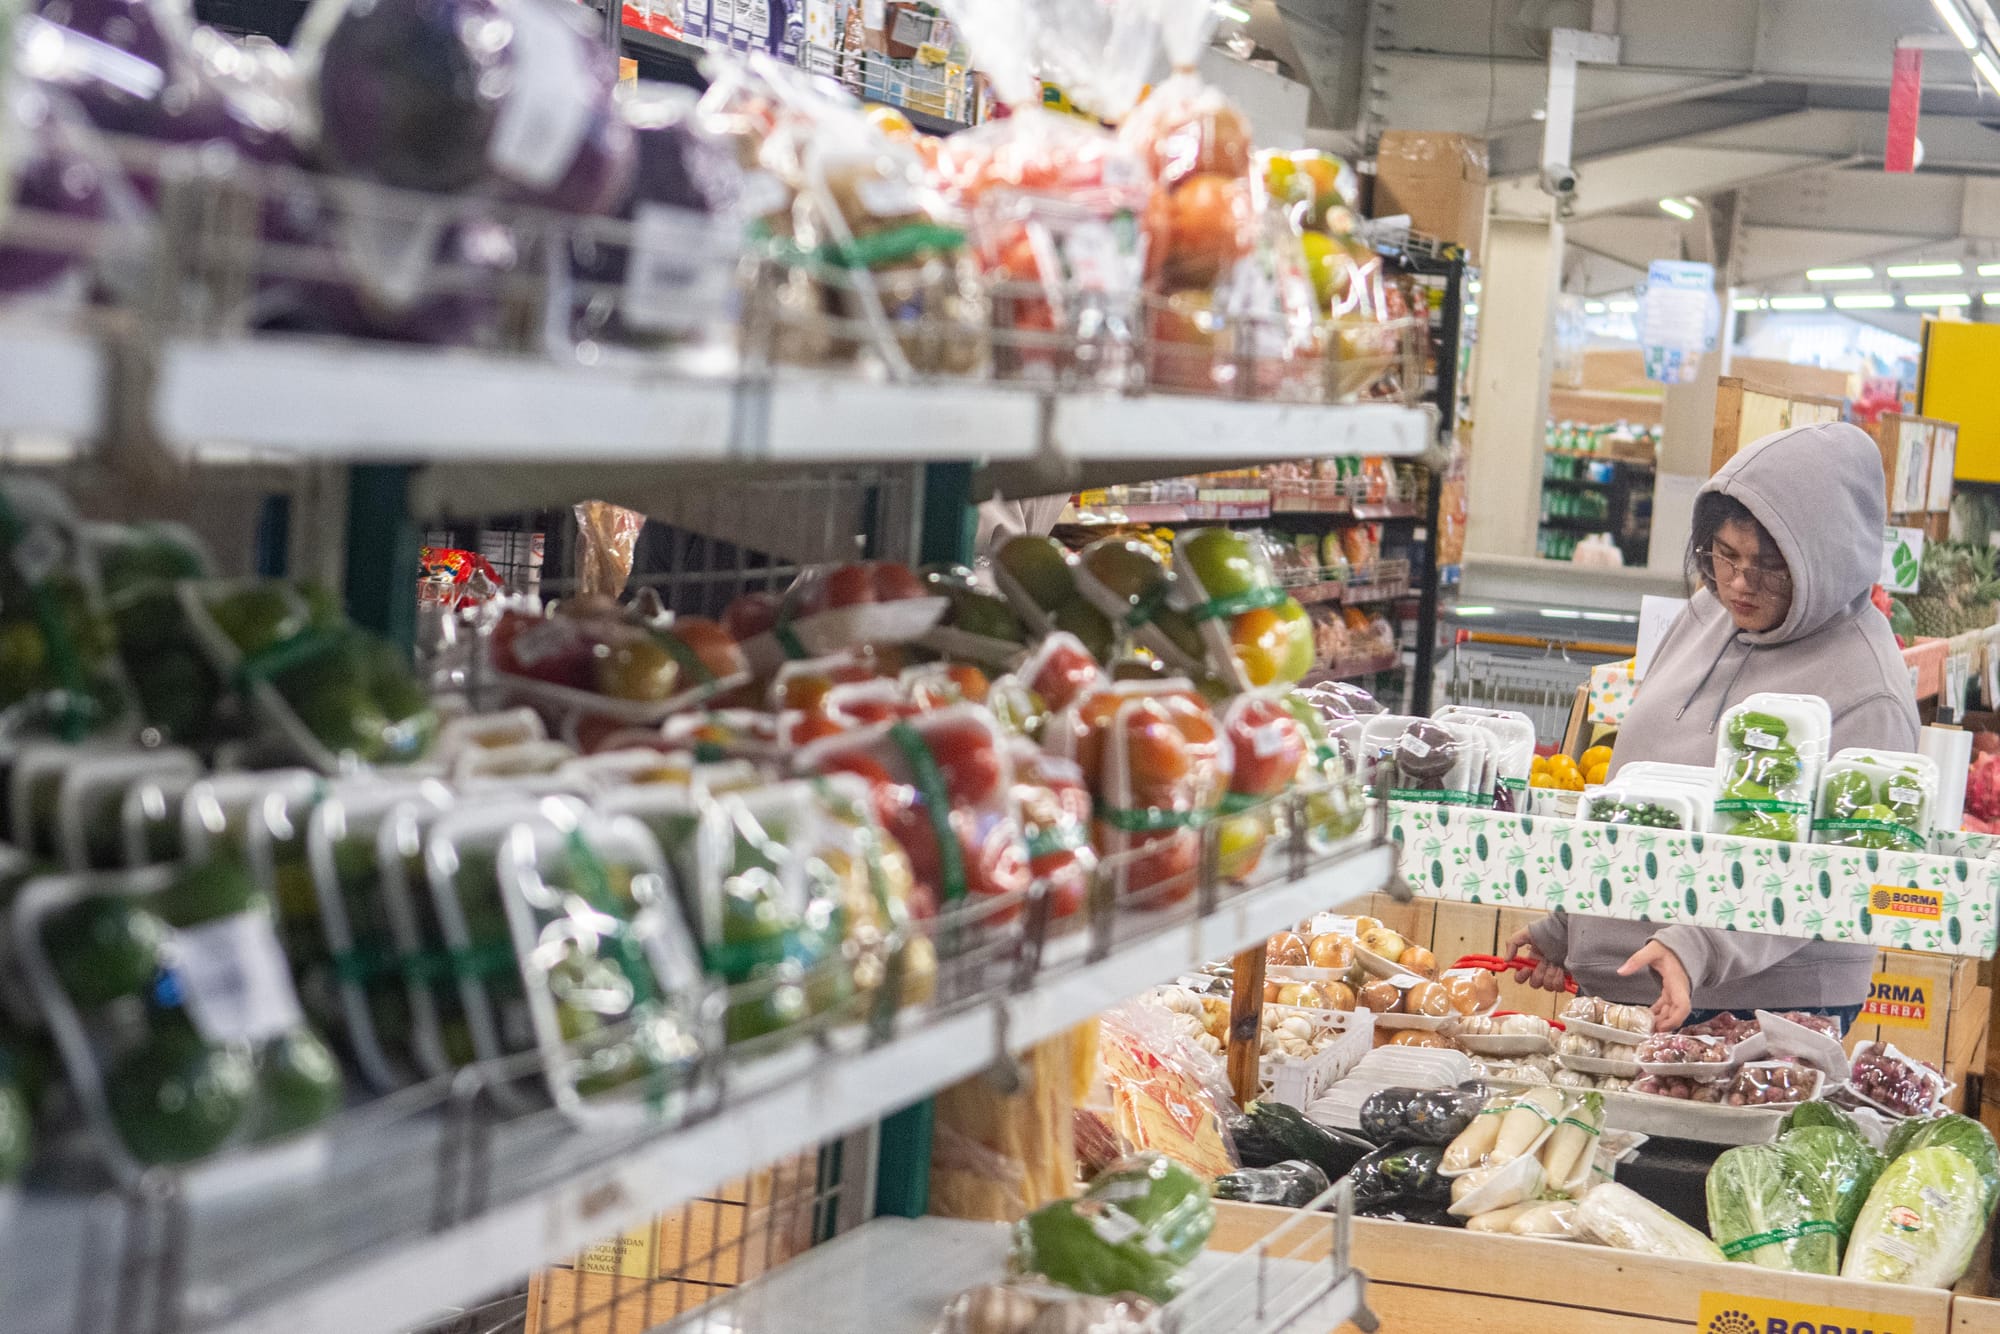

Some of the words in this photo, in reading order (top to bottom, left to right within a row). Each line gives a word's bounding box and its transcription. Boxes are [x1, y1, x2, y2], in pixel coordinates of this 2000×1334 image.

[1893, 892, 1937, 906] BORMA
[1893, 904, 1937, 914] TOSERBA
[1867, 983, 1924, 1004] ORMA
[1862, 1001, 1922, 1017] SERBA
[586, 1263, 616, 1272] NANAS
